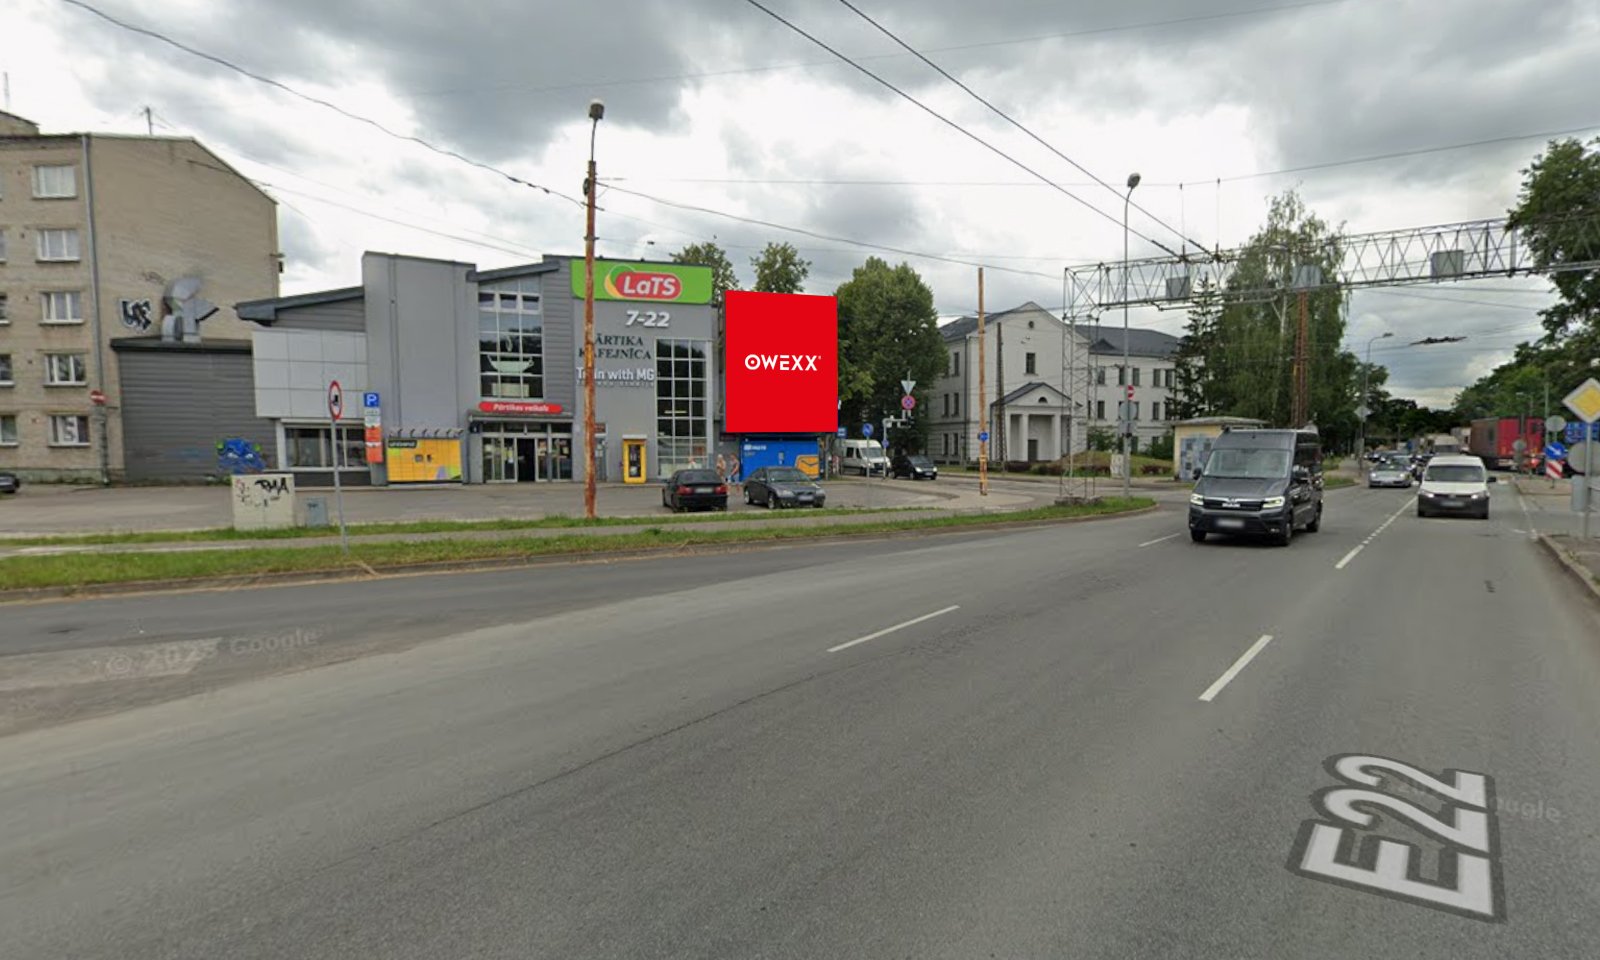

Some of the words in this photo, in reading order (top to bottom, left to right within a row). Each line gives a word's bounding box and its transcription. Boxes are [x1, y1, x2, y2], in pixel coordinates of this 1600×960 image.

[623, 276, 676, 295] LaTS
[625, 309, 671, 328] 7-22
[592, 333, 644, 347] ĀRTIKA
[578, 347, 652, 360] KFEJNĪCA
[744, 353, 818, 372] OWEXX
[608, 367, 635, 380] with
[636, 368, 655, 381] MG
[366, 393, 377, 406] P
